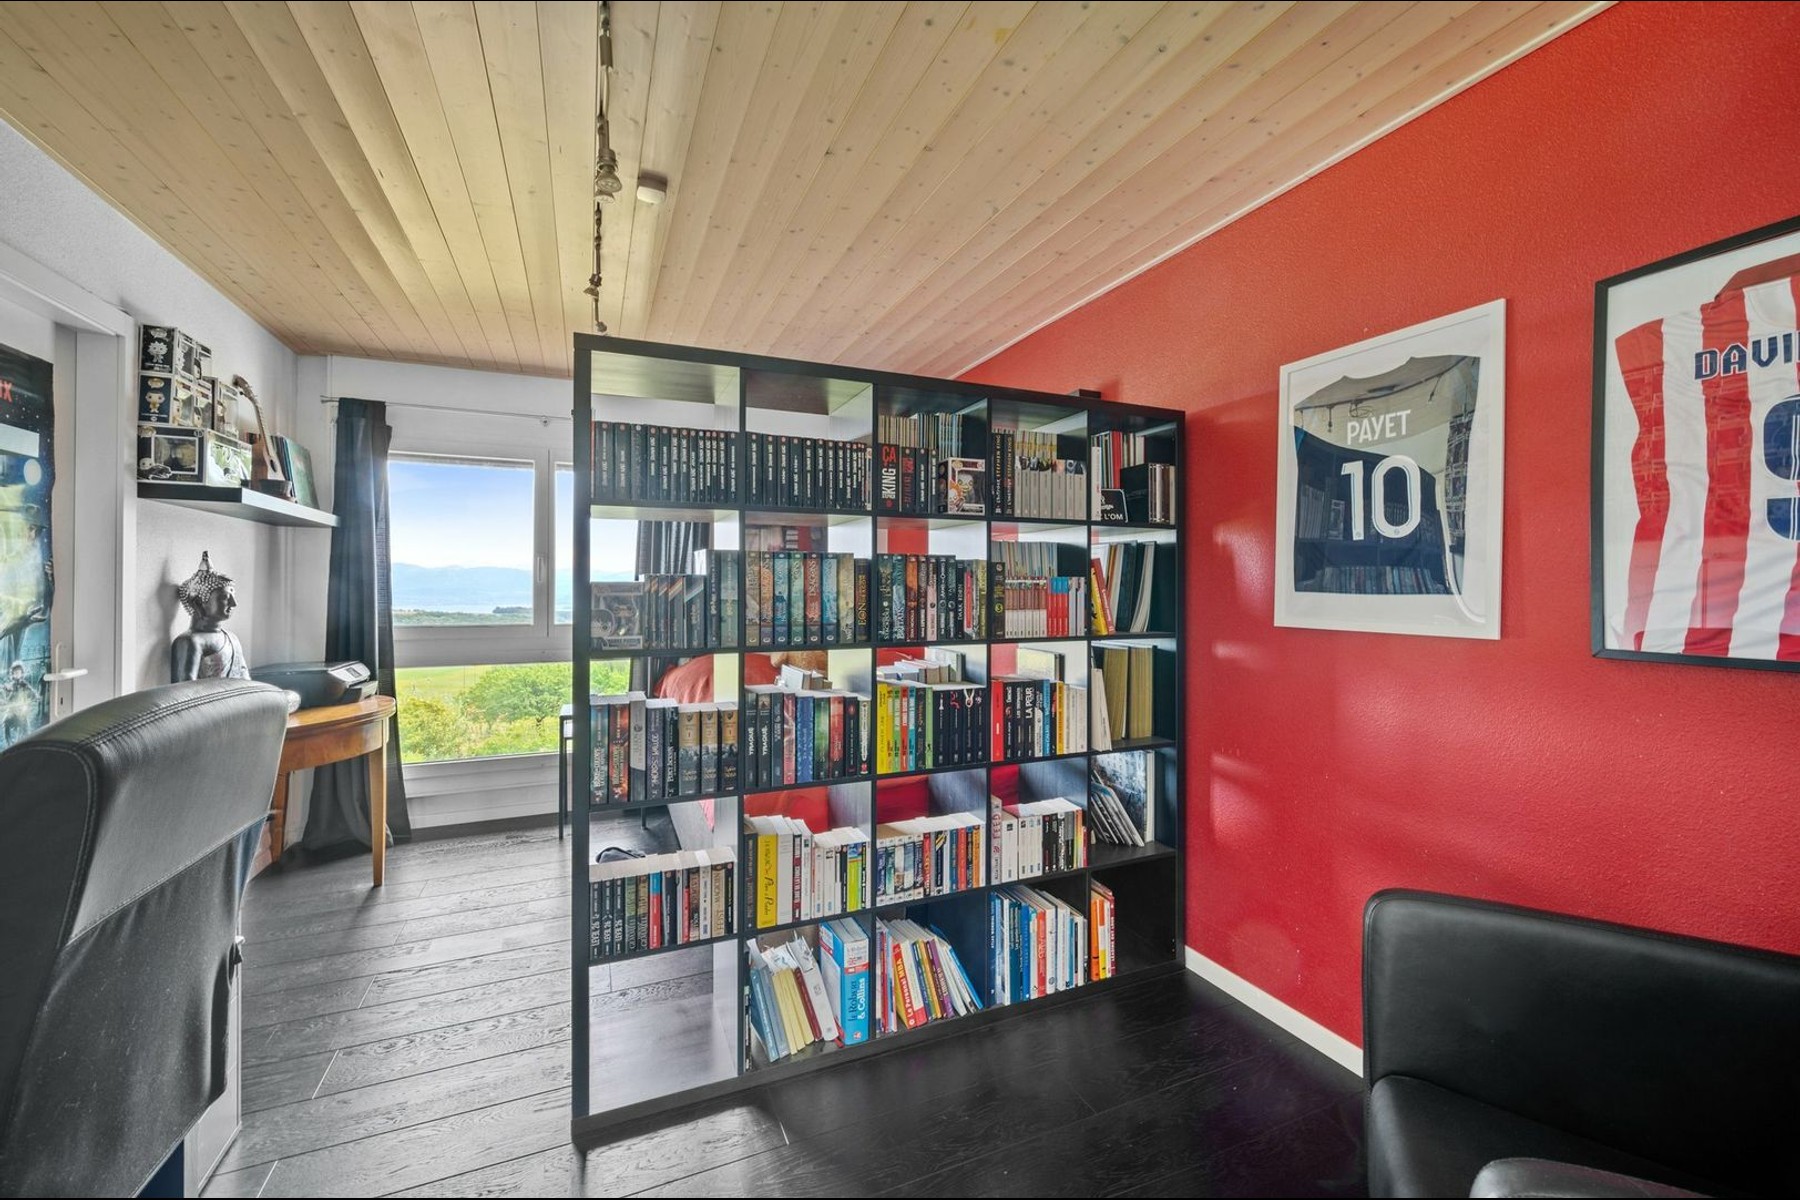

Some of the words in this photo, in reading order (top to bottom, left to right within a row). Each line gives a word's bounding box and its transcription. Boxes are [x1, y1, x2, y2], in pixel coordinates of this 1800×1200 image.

[1693, 328, 1800, 381] DAVI
[1346, 408, 1411, 445] PAYET
[881, 468, 896, 494] KING
[1340, 454, 1421, 542] 10
[1026, 708, 1032, 718] LA
[896, 958, 905, 978] MBA
[858, 1012, 865, 1020] &
